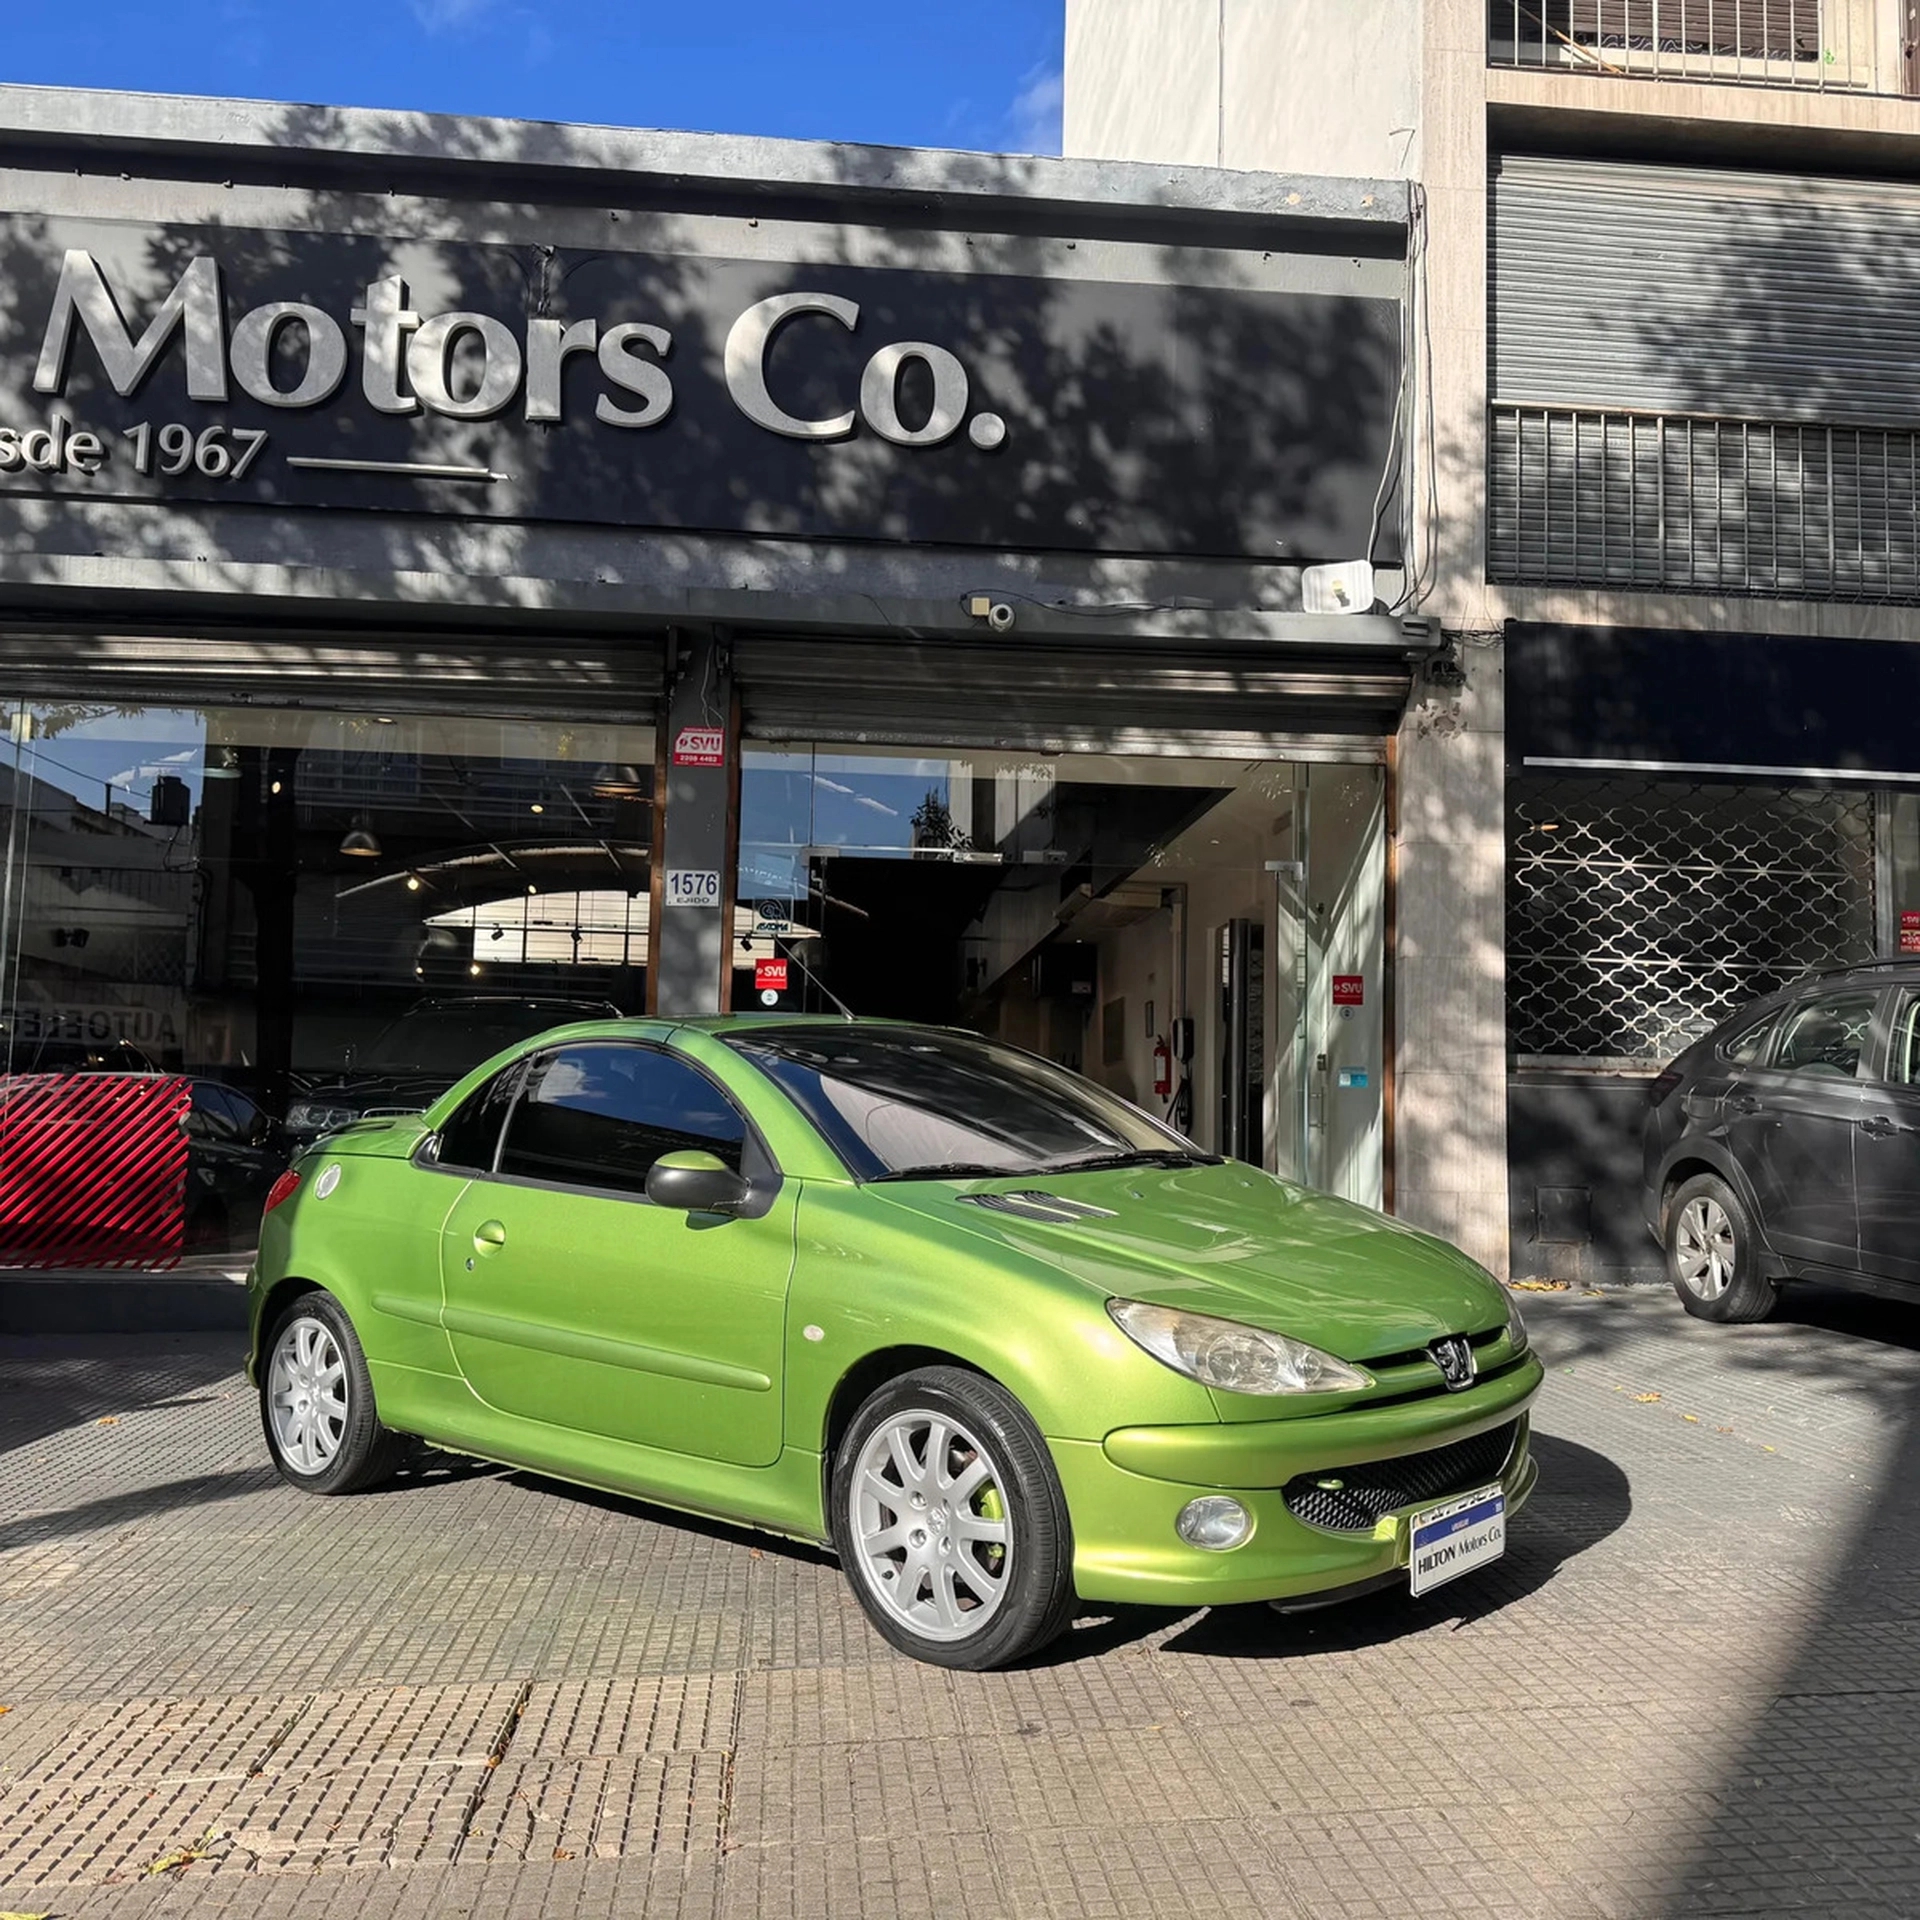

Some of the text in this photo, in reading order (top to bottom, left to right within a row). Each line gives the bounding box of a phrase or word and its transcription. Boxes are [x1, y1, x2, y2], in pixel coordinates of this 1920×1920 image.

[32, 249, 1006, 449] Motors Co.
[0, 414, 269, 479] sde 1967
[690, 736, 720, 751] SVU
[670, 873, 717, 895] 1576
[764, 966, 786, 977] SVU
[1341, 982, 1362, 993] SVU
[1418, 1545, 1456, 1575] HILTON
[1458, 1533, 1488, 1557] Motors
